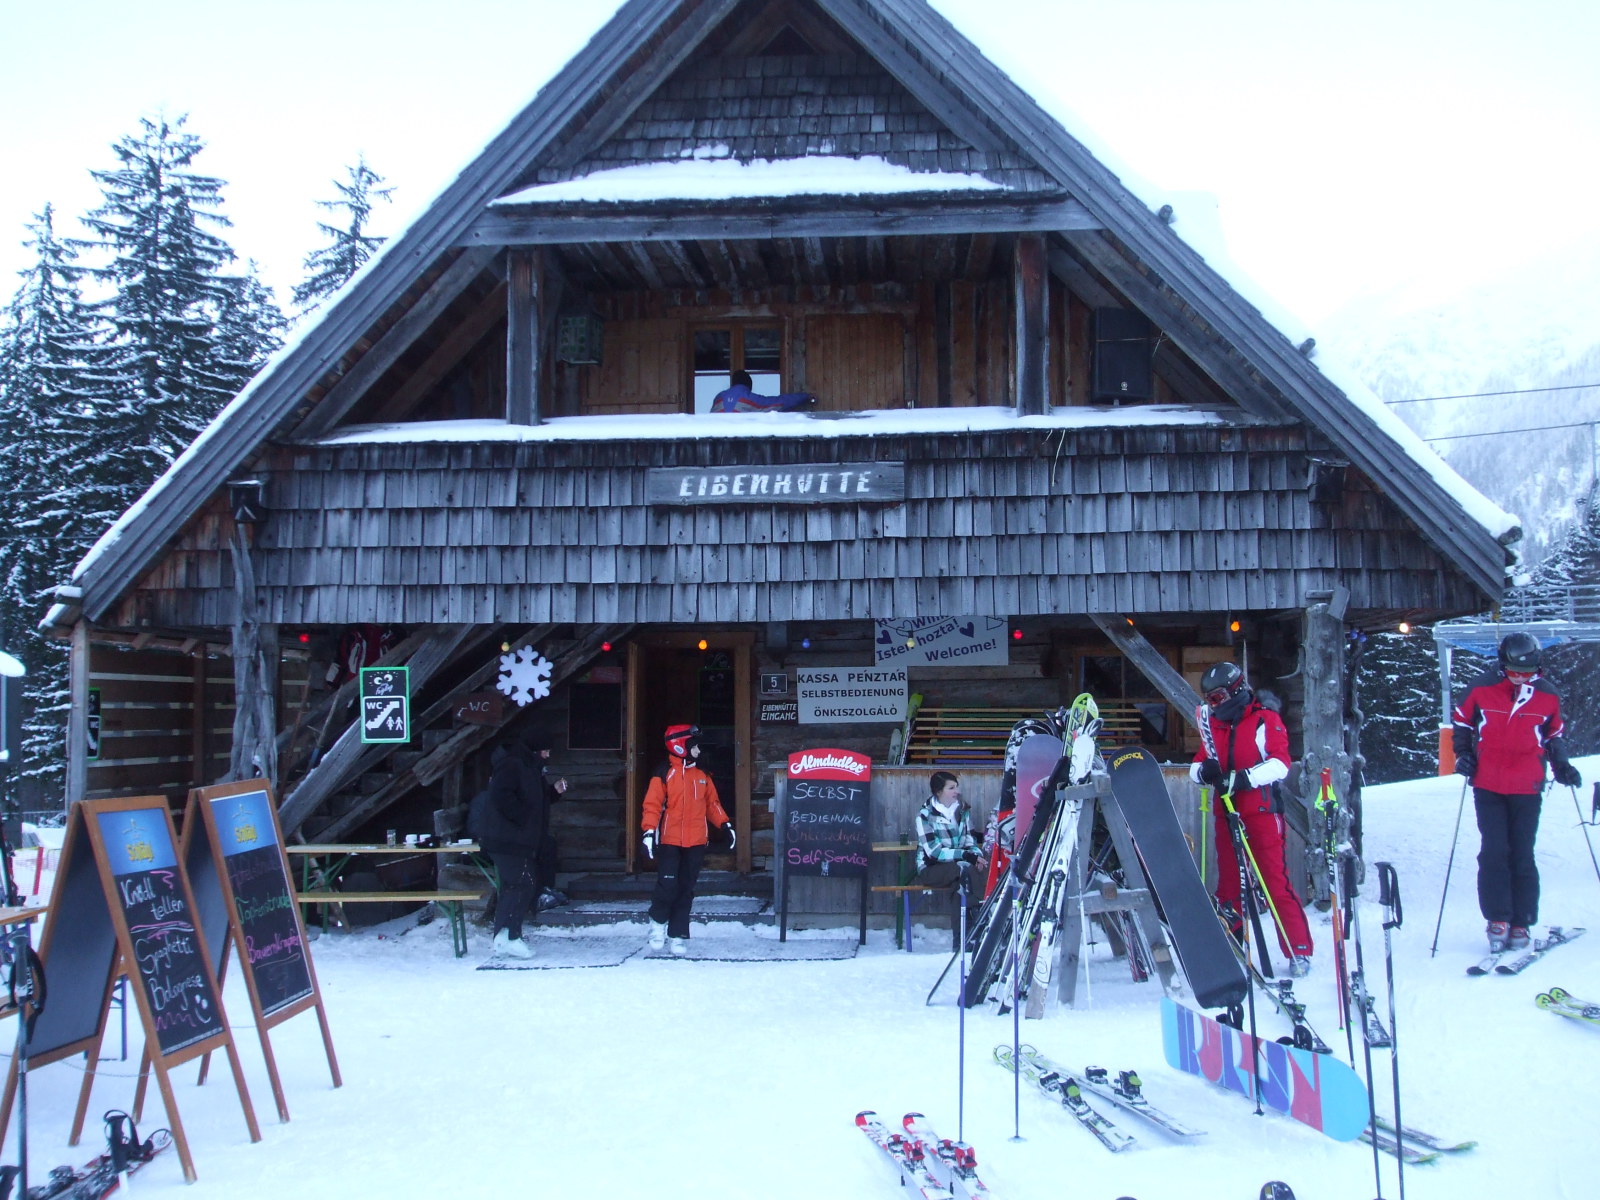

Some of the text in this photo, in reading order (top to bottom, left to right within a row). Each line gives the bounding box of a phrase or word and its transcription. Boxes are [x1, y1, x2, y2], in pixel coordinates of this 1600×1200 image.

[916, 617, 960, 647] hozta!
[925, 638, 997, 662] Welcome!
[771, 676, 778, 688] 5
[797, 669, 907, 683] KASSA PÉNZTÁR
[801, 688, 904, 698] SELBSTBEDIENUNG
[366, 701, 383, 710] WC
[469, 701, 490, 712] WC
[814, 704, 898, 717] ÖNKISZOLGÁLÓ
[761, 712, 797, 721] EINGANG
[790, 753, 866, 775] Almdudler
[793, 783, 862, 801] SELBST
[790, 811, 862, 824] BEDIENUNG
[787, 848, 869, 867] Self Service
[1239, 866, 1247, 890] LEKI
[135, 934, 194, 976] Spaghetti
[148, 975, 205, 1012] Bolognese
